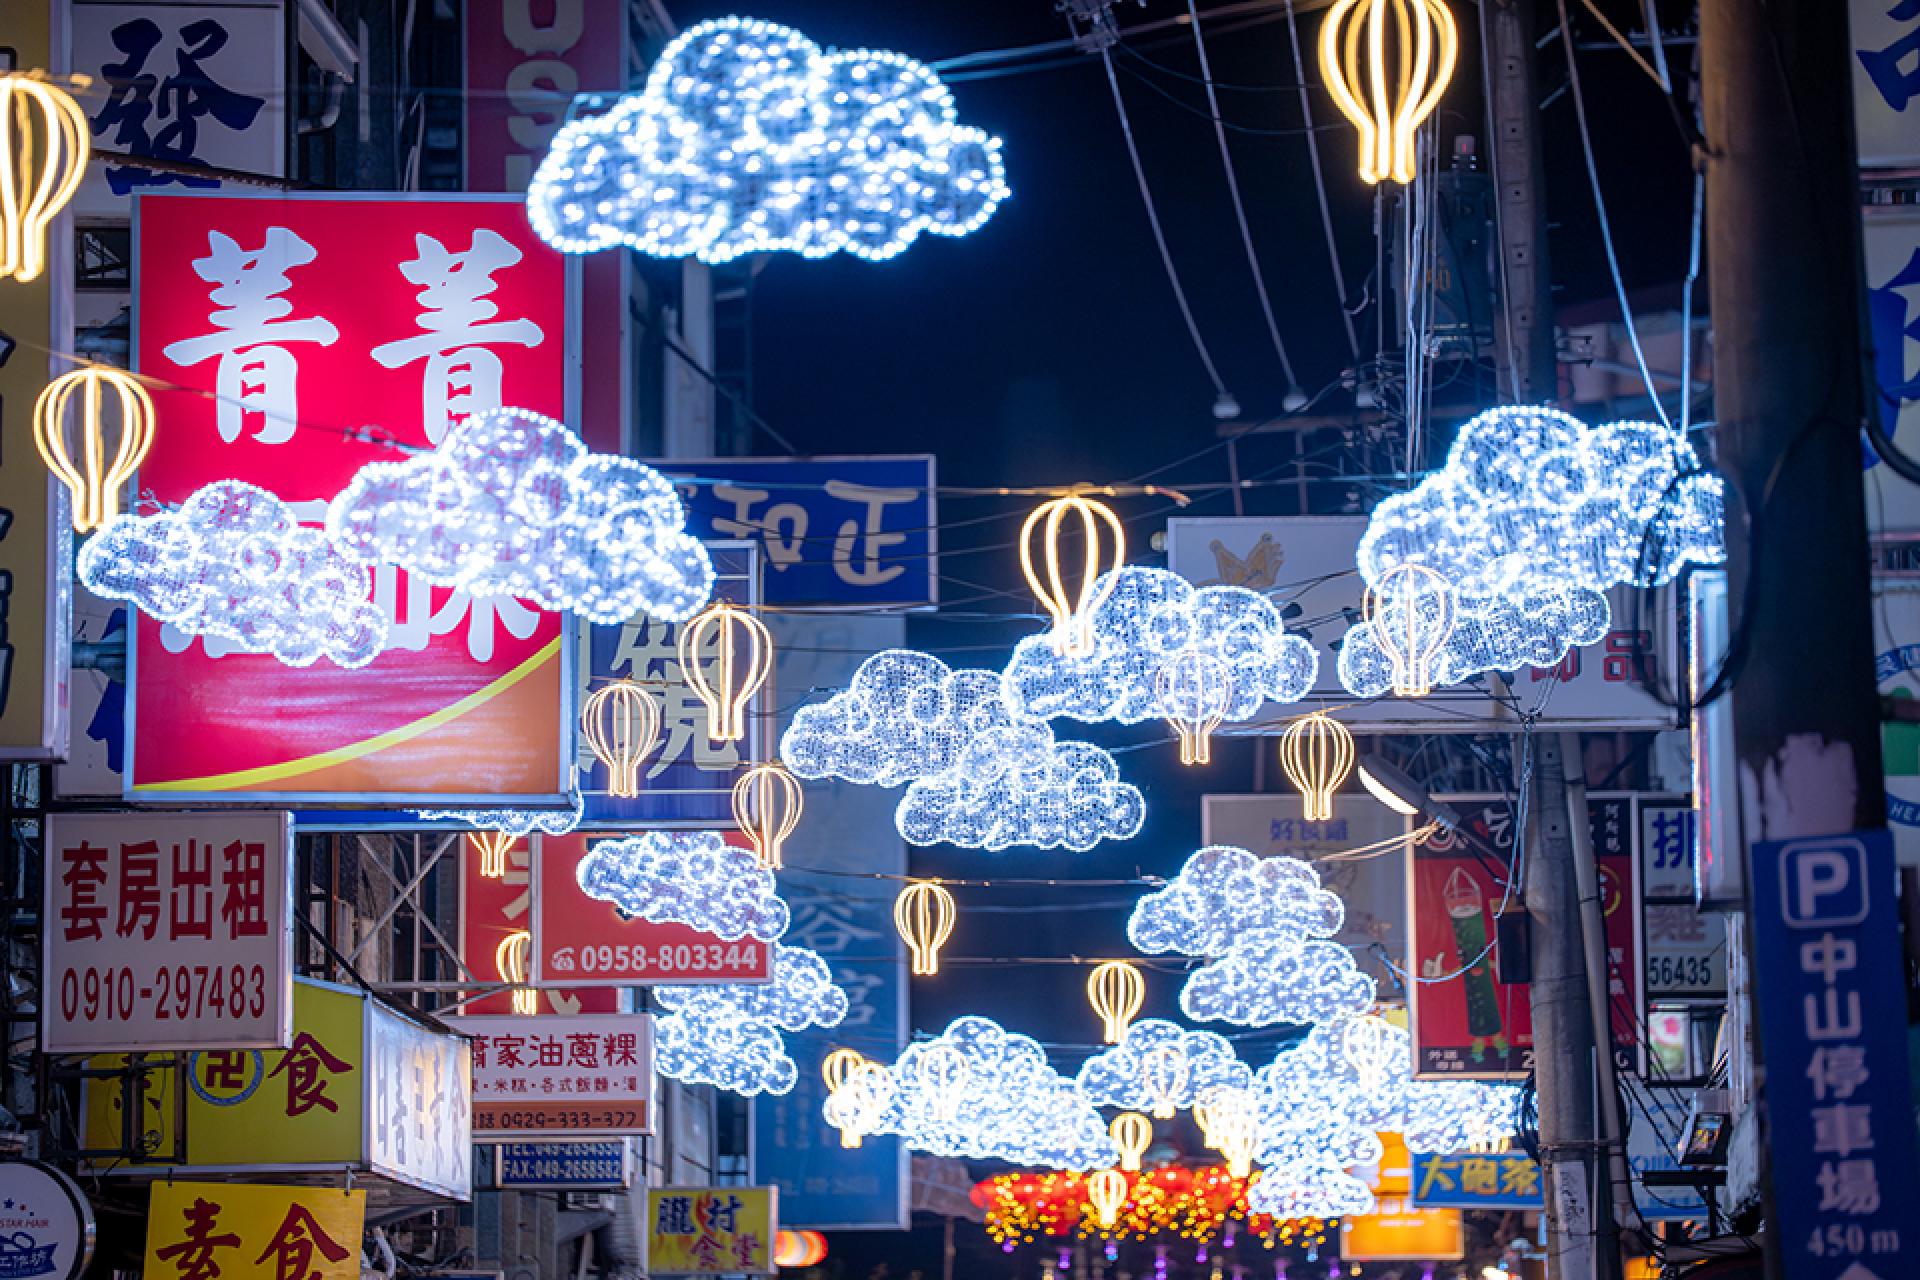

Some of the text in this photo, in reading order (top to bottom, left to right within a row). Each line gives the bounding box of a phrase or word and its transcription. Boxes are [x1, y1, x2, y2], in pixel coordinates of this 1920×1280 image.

[61, 839, 268, 941] 套房出租
[1798, 851, 1850, 918] P
[580, 944, 758, 972] 0958-803344
[62, 964, 266, 1021] 0910-297483
[268, 1031, 353, 1117] 食
[1801, 932, 1881, 1215] 中山停車場
[501, 1111, 637, 1129] 0929-333-377
[1807, 1226, 1865, 1256] 450
